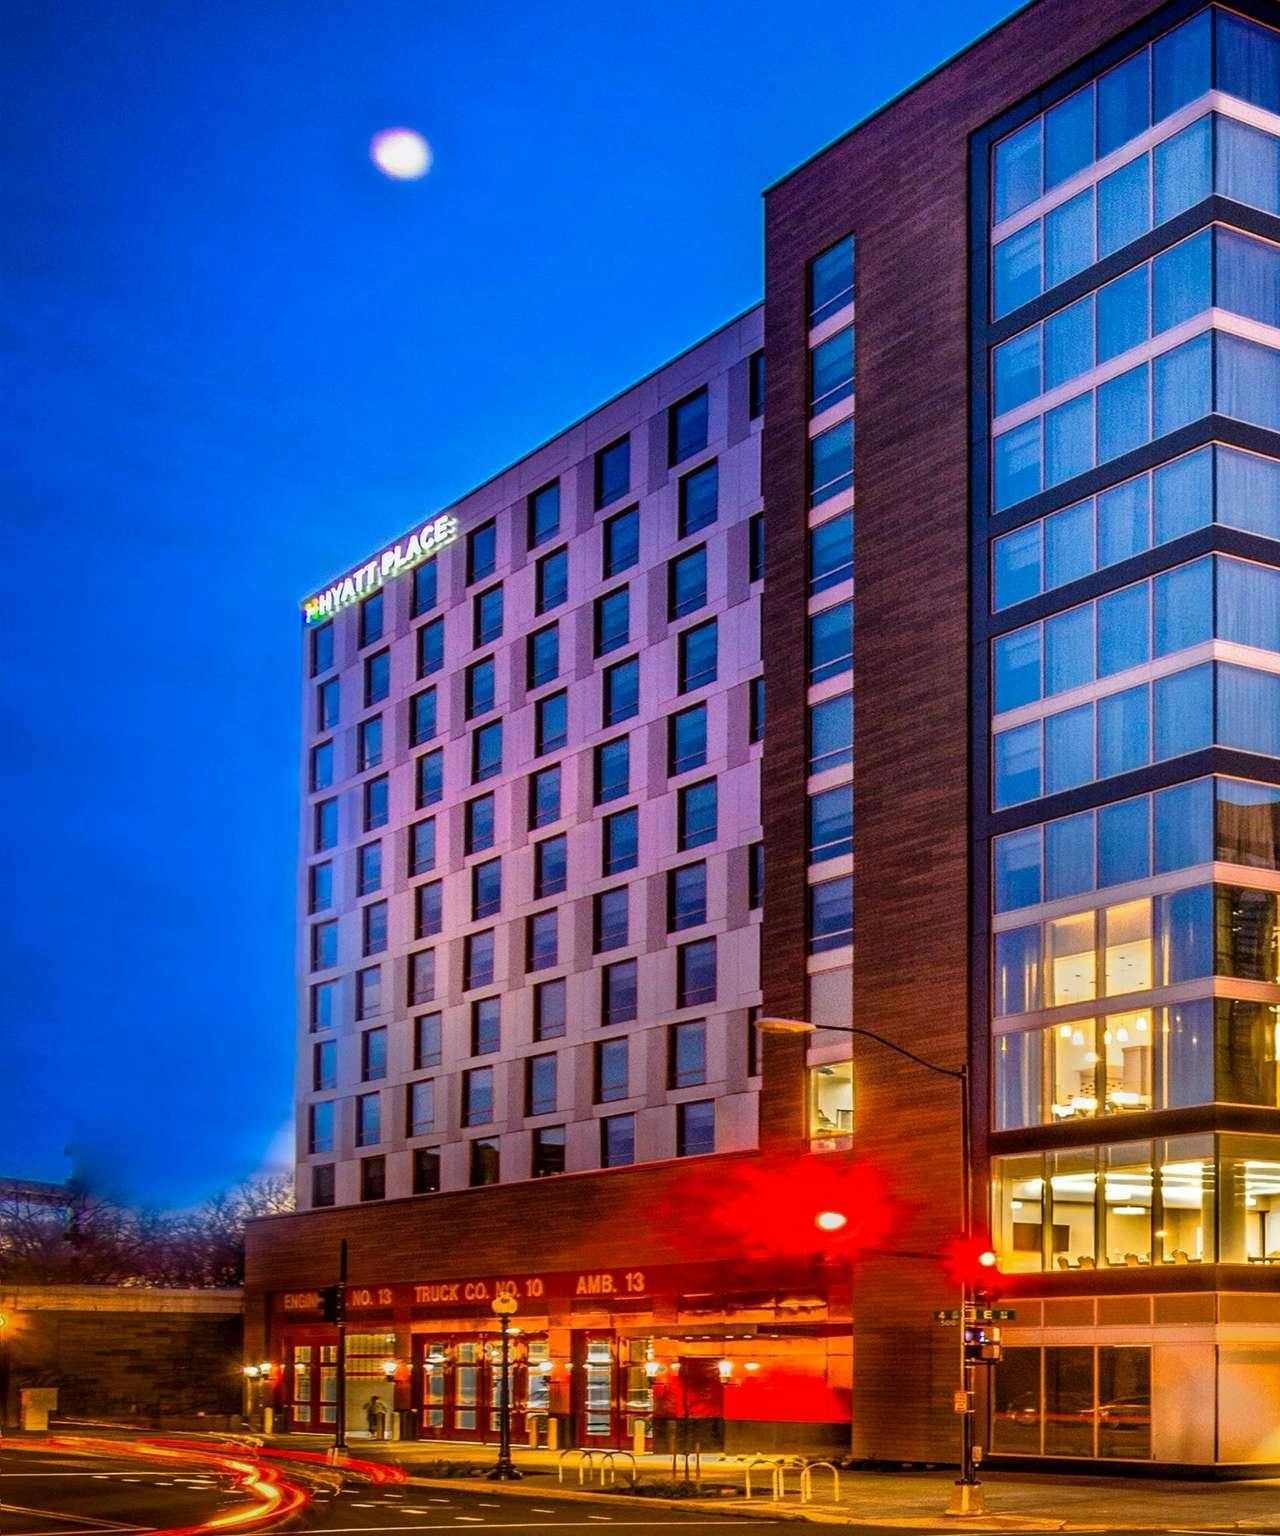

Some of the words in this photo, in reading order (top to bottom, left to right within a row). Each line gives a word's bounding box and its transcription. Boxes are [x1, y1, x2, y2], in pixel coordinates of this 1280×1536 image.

[319, 561, 377, 613] HYATT
[381, 515, 449, 577] PLACE
[414, 1284, 459, 1303] TRUCK
[464, 1282, 490, 1300] CO.
[526, 1278, 543, 1297] 10
[575, 1273, 617, 1295] AMB.
[625, 1271, 645, 1292] 13
[352, 1289, 374, 1307] NO.
[378, 1287, 393, 1305] 13
[983, 1310, 993, 1319] E
